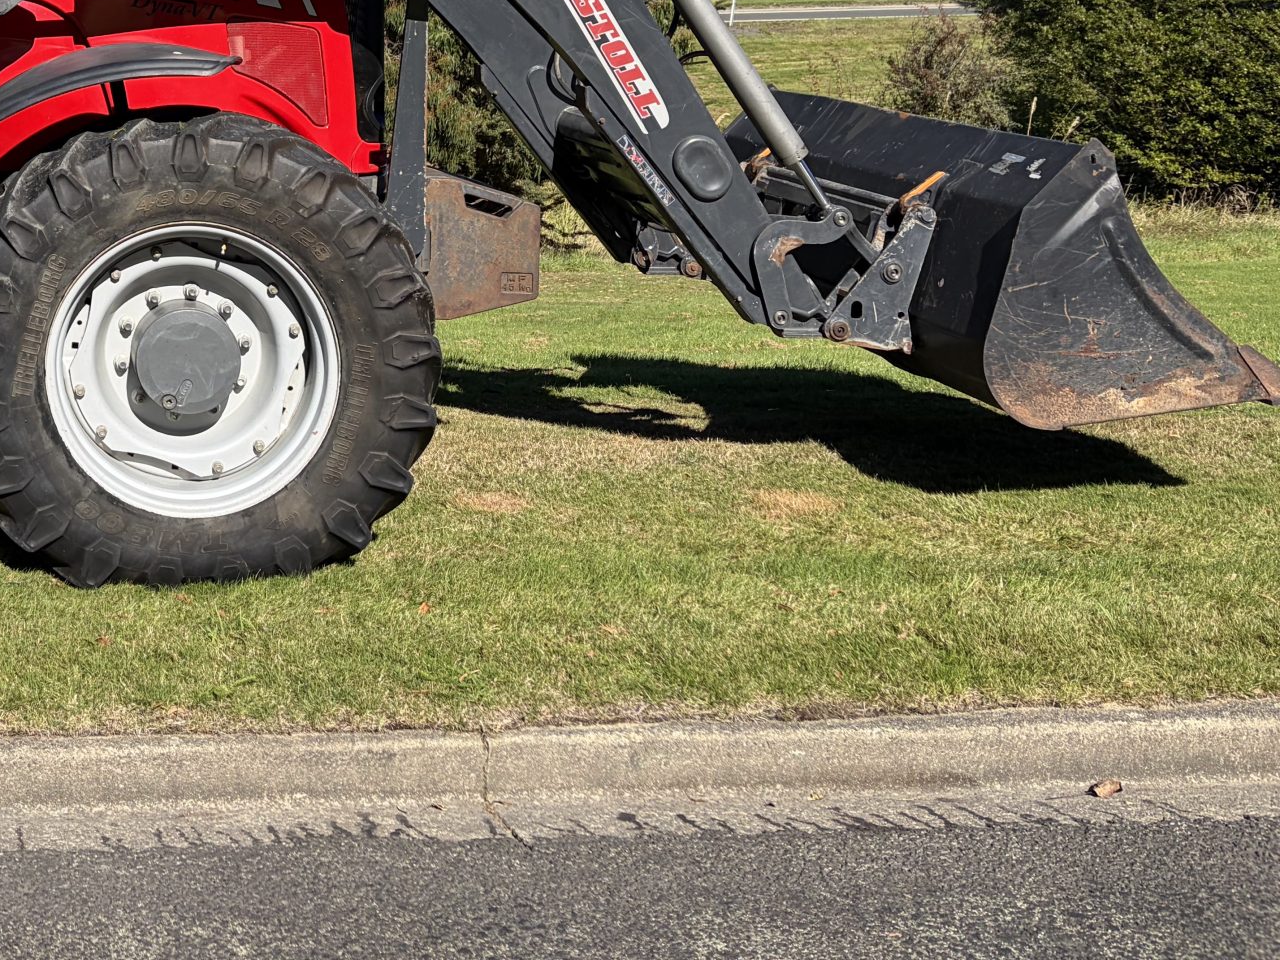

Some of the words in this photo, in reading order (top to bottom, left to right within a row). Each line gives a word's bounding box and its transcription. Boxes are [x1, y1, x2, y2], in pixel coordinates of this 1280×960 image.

[135, 188, 263, 216] 480/65
[265, 208, 291, 231] R
[290, 226, 333, 262] 28
[11, 253, 68, 397] TRELLEBORG
